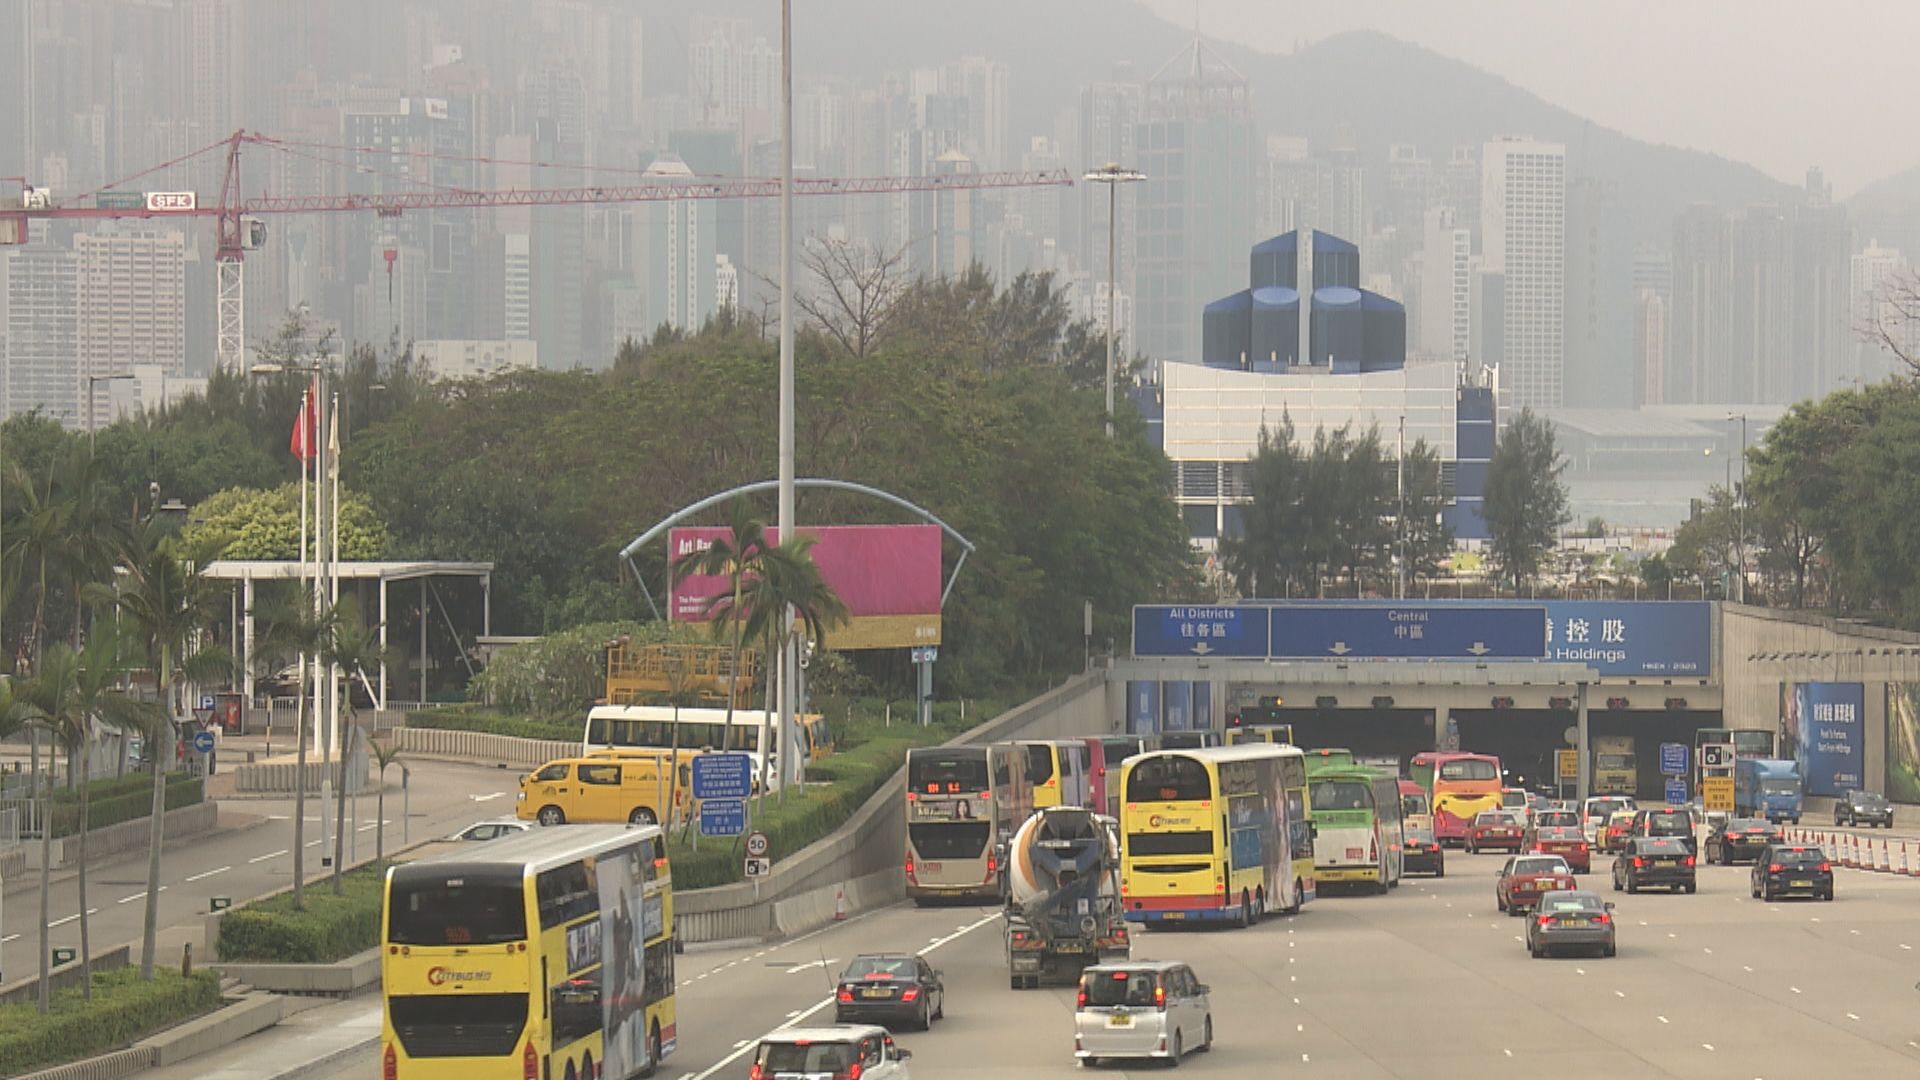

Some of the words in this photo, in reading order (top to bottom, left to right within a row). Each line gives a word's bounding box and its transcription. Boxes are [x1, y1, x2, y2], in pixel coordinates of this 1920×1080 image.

[679, 538, 692, 555] Art
[1170, 608, 1185, 619] All
[1188, 608, 1235, 619] Districts
[1388, 610, 1429, 622] Central
[1394, 624, 1424, 639] 中區
[1556, 647, 1626, 663] Holdings
[202, 696, 214, 709] P
[750, 839, 766, 849] 50
